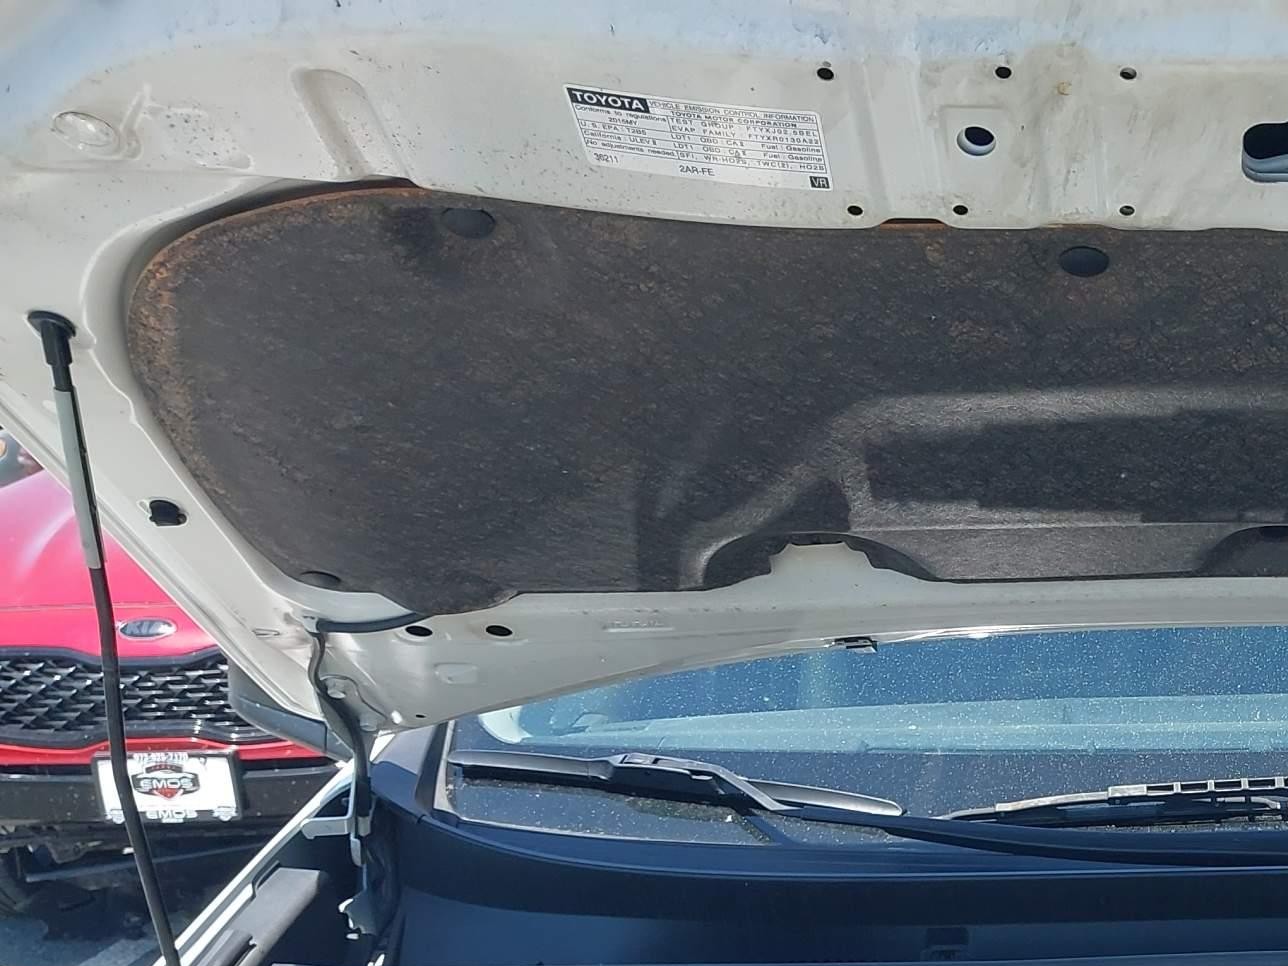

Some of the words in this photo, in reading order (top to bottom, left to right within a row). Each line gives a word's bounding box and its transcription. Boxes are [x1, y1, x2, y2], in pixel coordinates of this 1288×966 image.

[572, 91, 645, 110] TOYOTA
[648, 101, 680, 110] VEHICLE
[684, 104, 720, 114] EMISSION
[724, 109, 758, 118] CONTROL
[764, 113, 815, 122] INFORMATION
[670, 117, 693, 125] TEST
[671, 111, 702, 119] TOYOTA
[738, 118, 797, 128] CORPORATION
[671, 125, 696, 133] EVAP
[703, 129, 736, 138] FAMILY
[680, 165, 716, 176] 2AR-FE
[811, 177, 829, 187] VR
